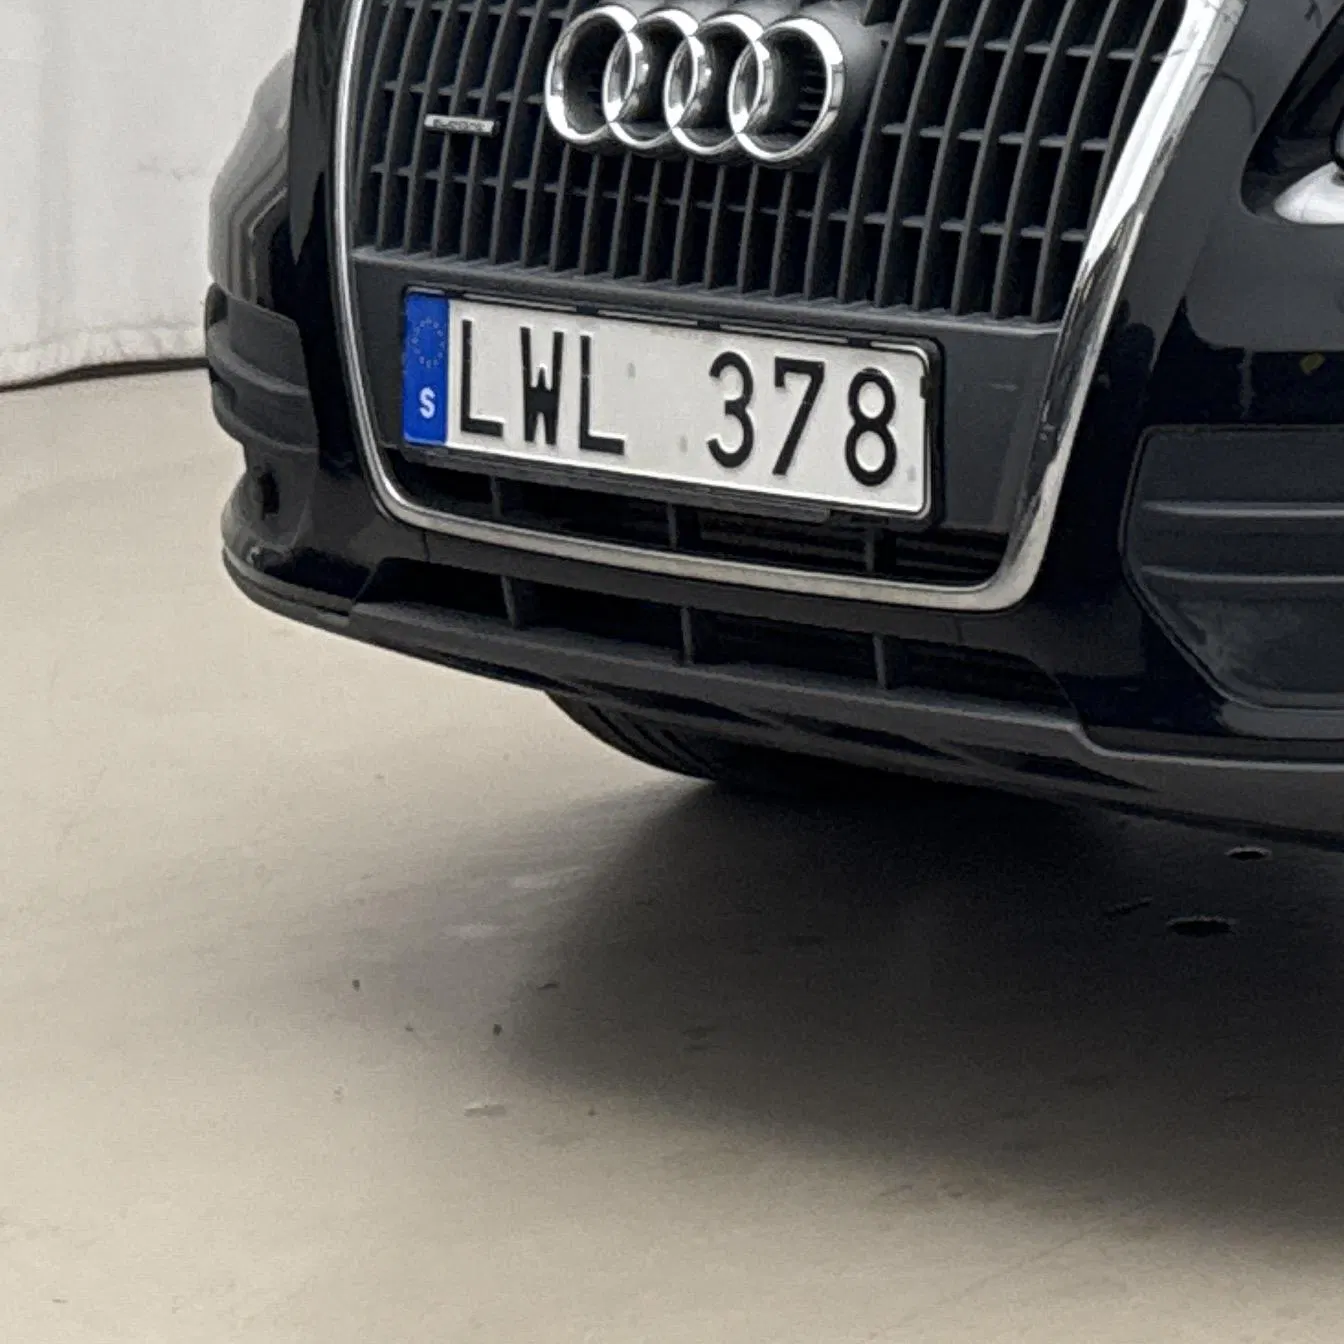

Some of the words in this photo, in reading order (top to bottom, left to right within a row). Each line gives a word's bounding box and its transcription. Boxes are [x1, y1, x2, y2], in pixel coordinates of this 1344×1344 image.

[419, 386, 437, 419] S
[460, 318, 626, 457] LWL
[706, 350, 898, 487] 378
